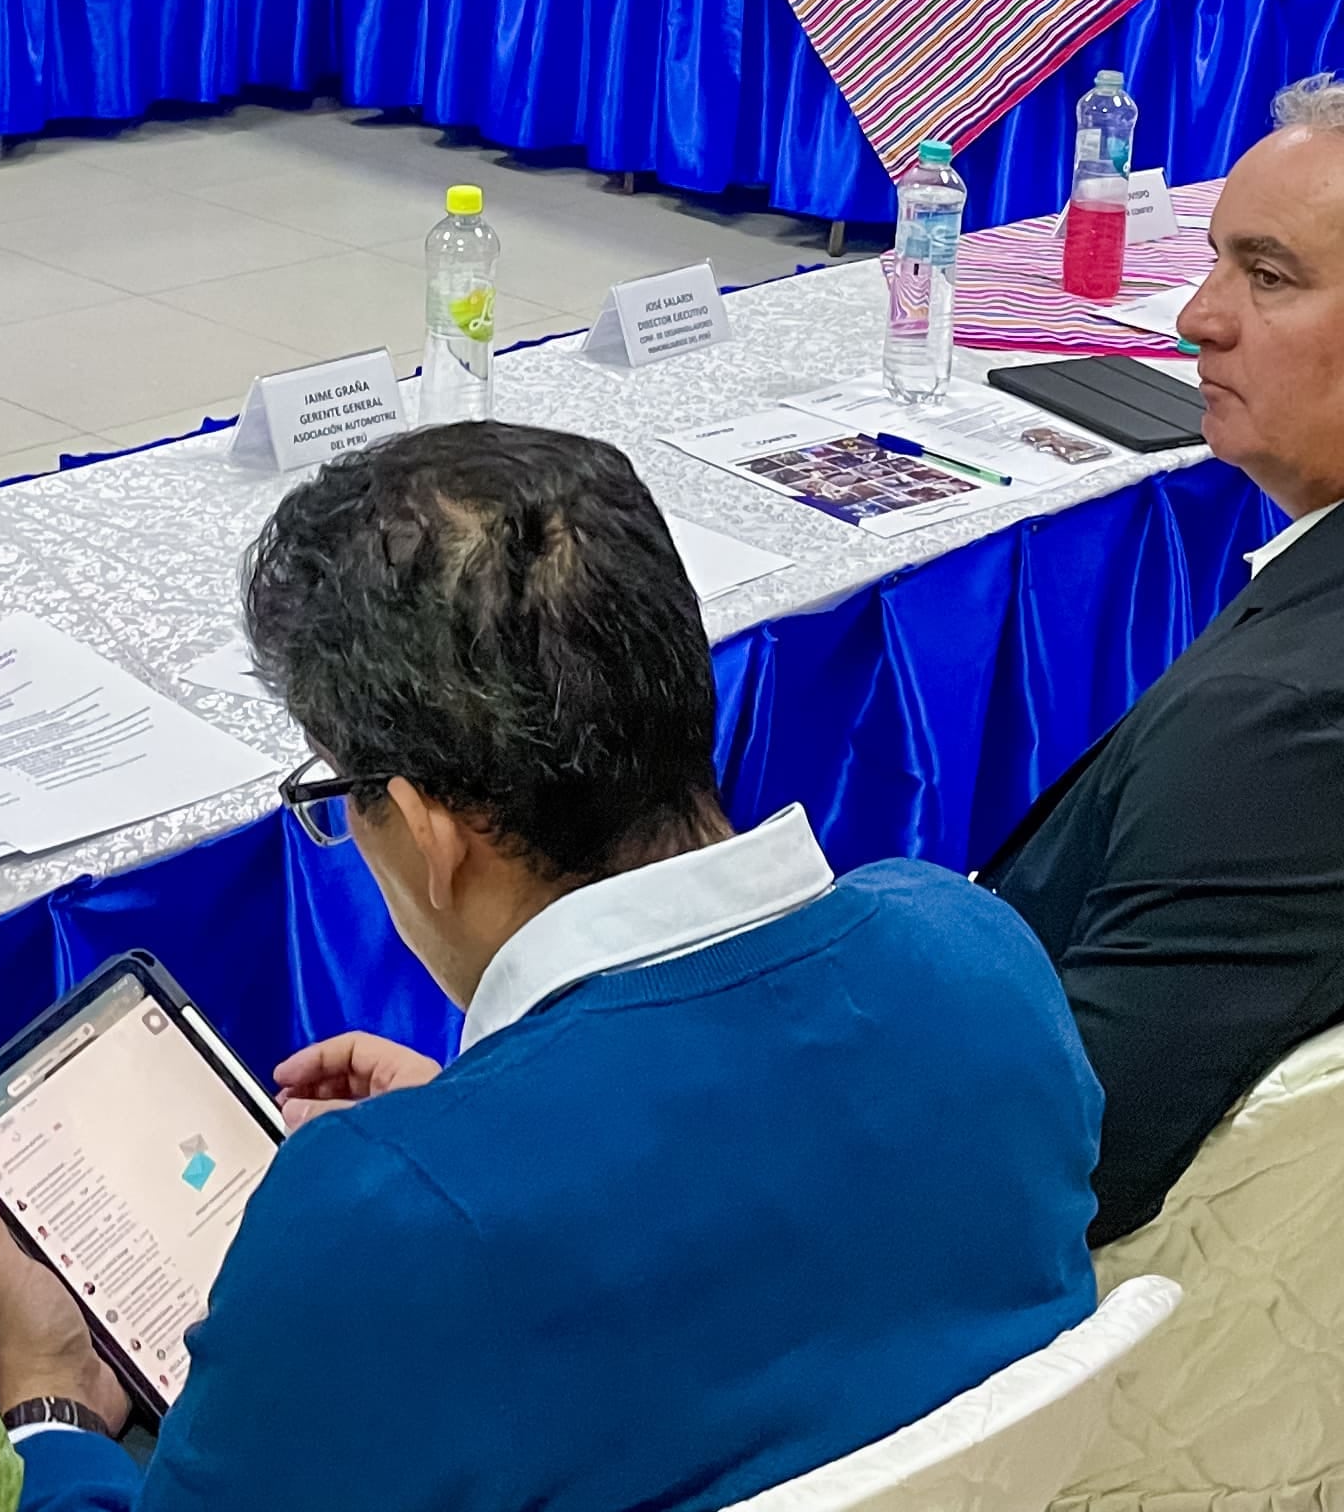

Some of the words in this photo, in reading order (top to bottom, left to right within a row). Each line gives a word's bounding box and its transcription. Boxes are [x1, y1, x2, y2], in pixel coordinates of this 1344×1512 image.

[335, 380, 370, 398] GRAÑA
[300, 408, 340, 425] GERENTE
[343, 397, 383, 415] GENERAL
[331, 440, 345, 451] DEL
